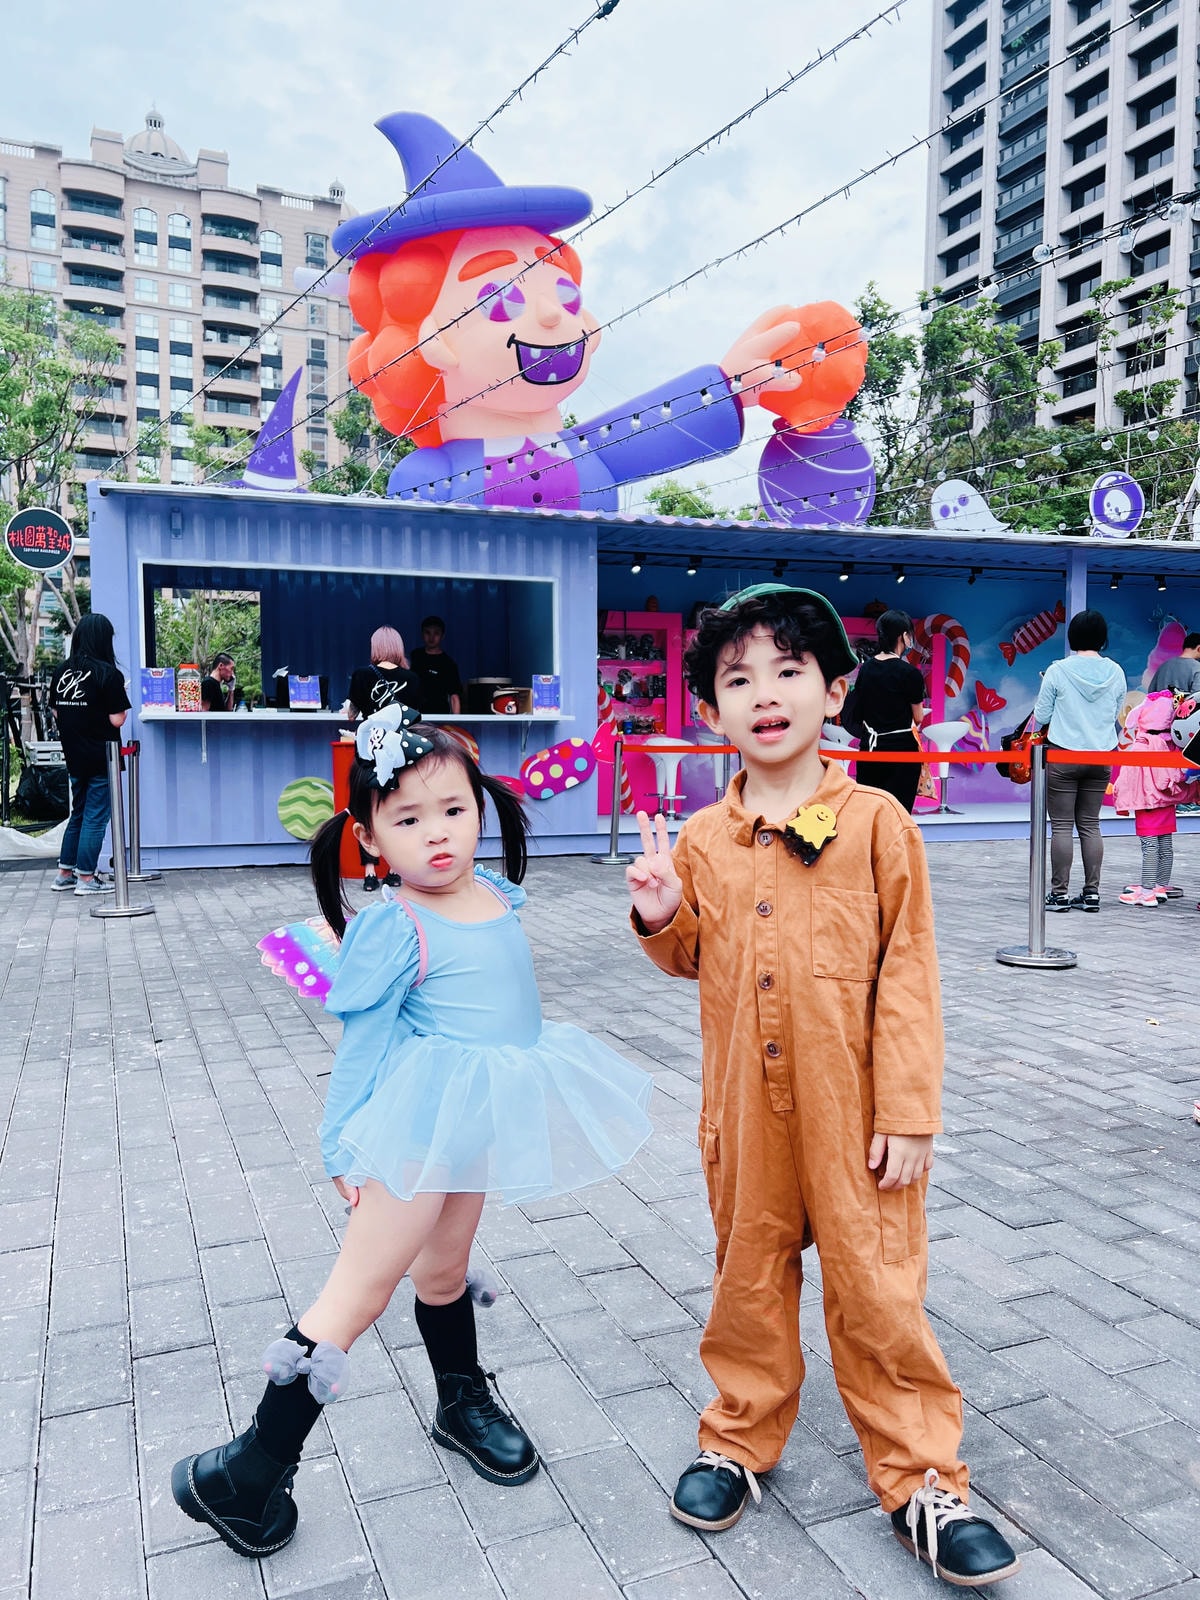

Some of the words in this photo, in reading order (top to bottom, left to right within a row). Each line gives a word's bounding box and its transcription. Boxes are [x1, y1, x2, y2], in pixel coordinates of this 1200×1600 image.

[8, 525, 71, 551] 桃園萬聖城
